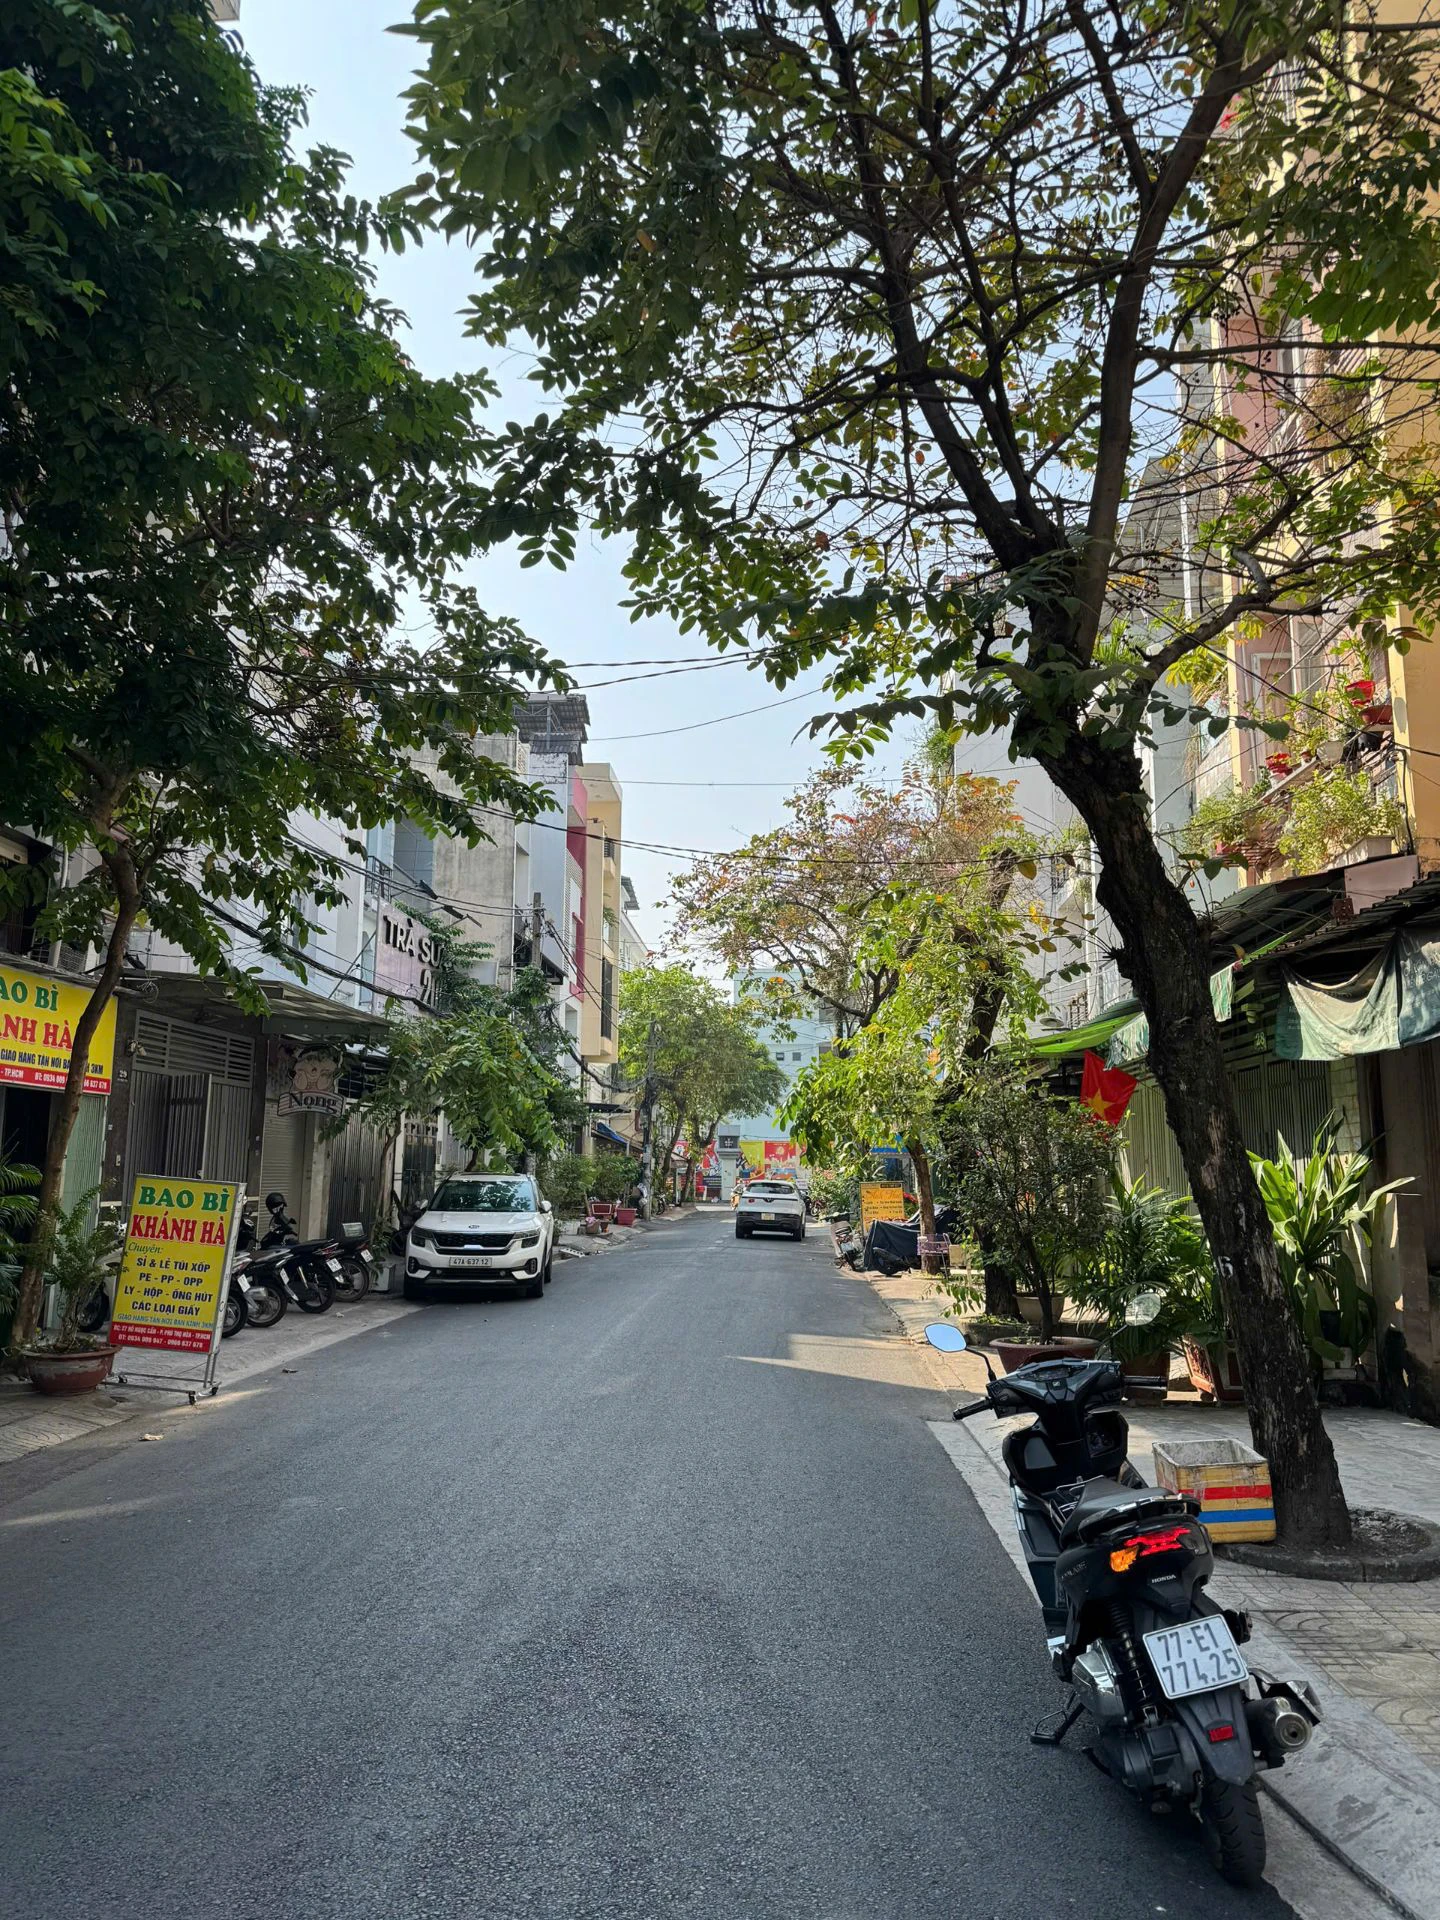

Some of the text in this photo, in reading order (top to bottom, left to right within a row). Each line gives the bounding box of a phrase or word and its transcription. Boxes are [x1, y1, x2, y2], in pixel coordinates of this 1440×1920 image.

[383, 915, 415, 957] TRÀ
[34, 984, 58, 1012] BÌ
[0, 1013, 72, 1052] NH HÀ
[0, 1048, 16, 1061] GIAO
[139, 1186, 230, 1213] BAO BÌ
[130, 1211, 226, 1245] KHÁNH HÀ
[128, 1241, 164, 1254] Chuyên:
[136, 1255, 211, 1272] SỈ & LẺ TÚI XỐP
[139, 1272, 152, 1282] PE
[161, 1274, 174, 1283] PP
[183, 1277, 203, 1286] OPP
[124, 1285, 135, 1295] LY
[143, 1287, 163, 1299] HỘP
[172, 1288, 192, 1300] ỐNG
[194, 1291, 213, 1302] HÚT
[132, 1300, 200, 1316] CÁC LOẠI GIẤY
[1151, 1574, 1177, 1583] HONDA
[1162, 1649, 1241, 1694] 774.25
